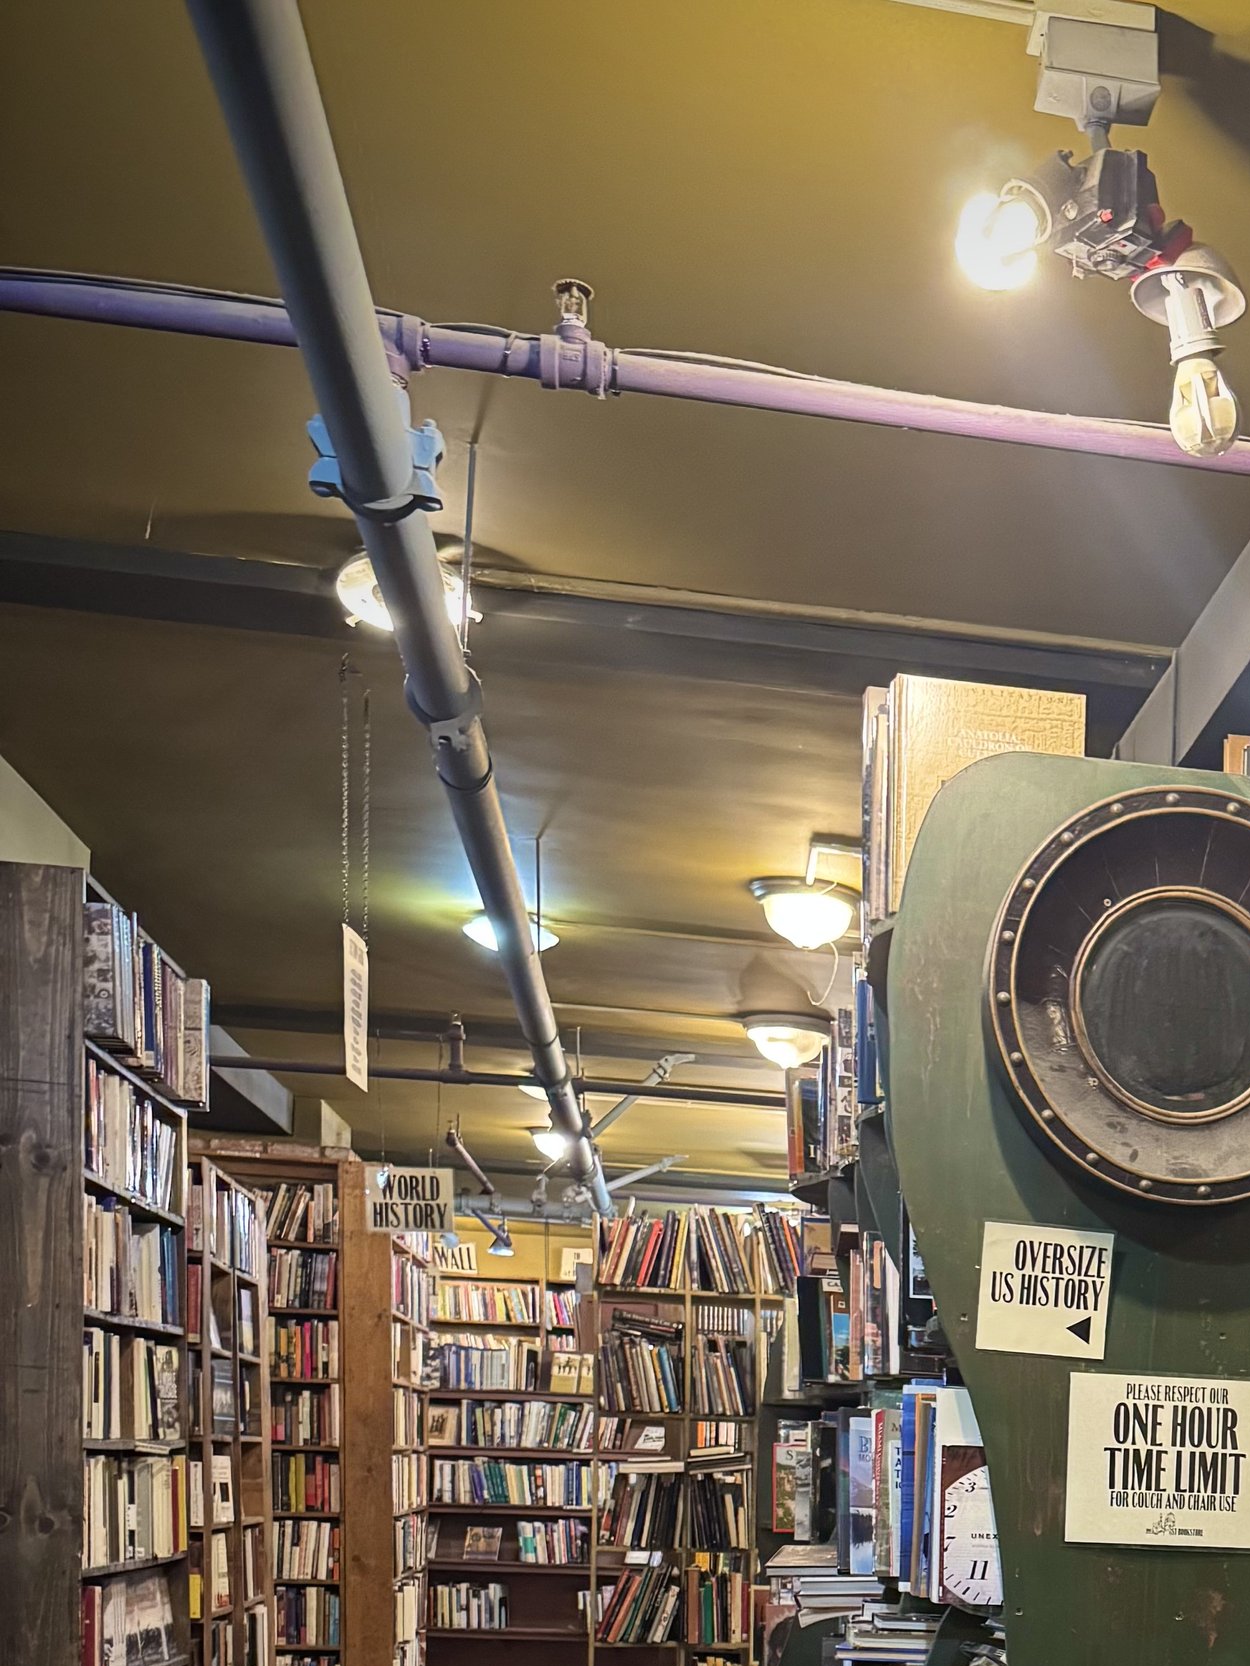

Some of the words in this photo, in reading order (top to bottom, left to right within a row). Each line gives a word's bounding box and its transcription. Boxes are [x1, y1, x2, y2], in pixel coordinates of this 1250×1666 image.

[380, 1174, 440, 1202] WORLD
[373, 1202, 448, 1229] HISTORY
[433, 1246, 476, 1271] WALL
[1015, 1239, 1108, 1279] OVERSIZE
[991, 1271, 1015, 1304] US
[1019, 1276, 1105, 1311] HISTORY
[1126, 1383, 1163, 1402] PLEASE
[1164, 1385, 1207, 1404] RESPECT
[1209, 1387, 1229, 1404] OUR
[1113, 1402, 1164, 1448] ONE
[1171, 1406, 1239, 1451] HOUR
[1103, 1447, 1169, 1492] TIME
[1175, 1450, 1247, 1496] LIMIT
[1110, 1490, 1131, 1507] FOR
[1132, 1492, 1163, 1509] COUCH
[1164, 1493, 1185, 1510] AND
[1187, 1494, 1216, 1512] CHAIR
[1218, 1495, 1237, 1512] USE
[1178, 1528, 1204, 1537] BOOKSTORE
[965, 1560, 989, 1581] 11
